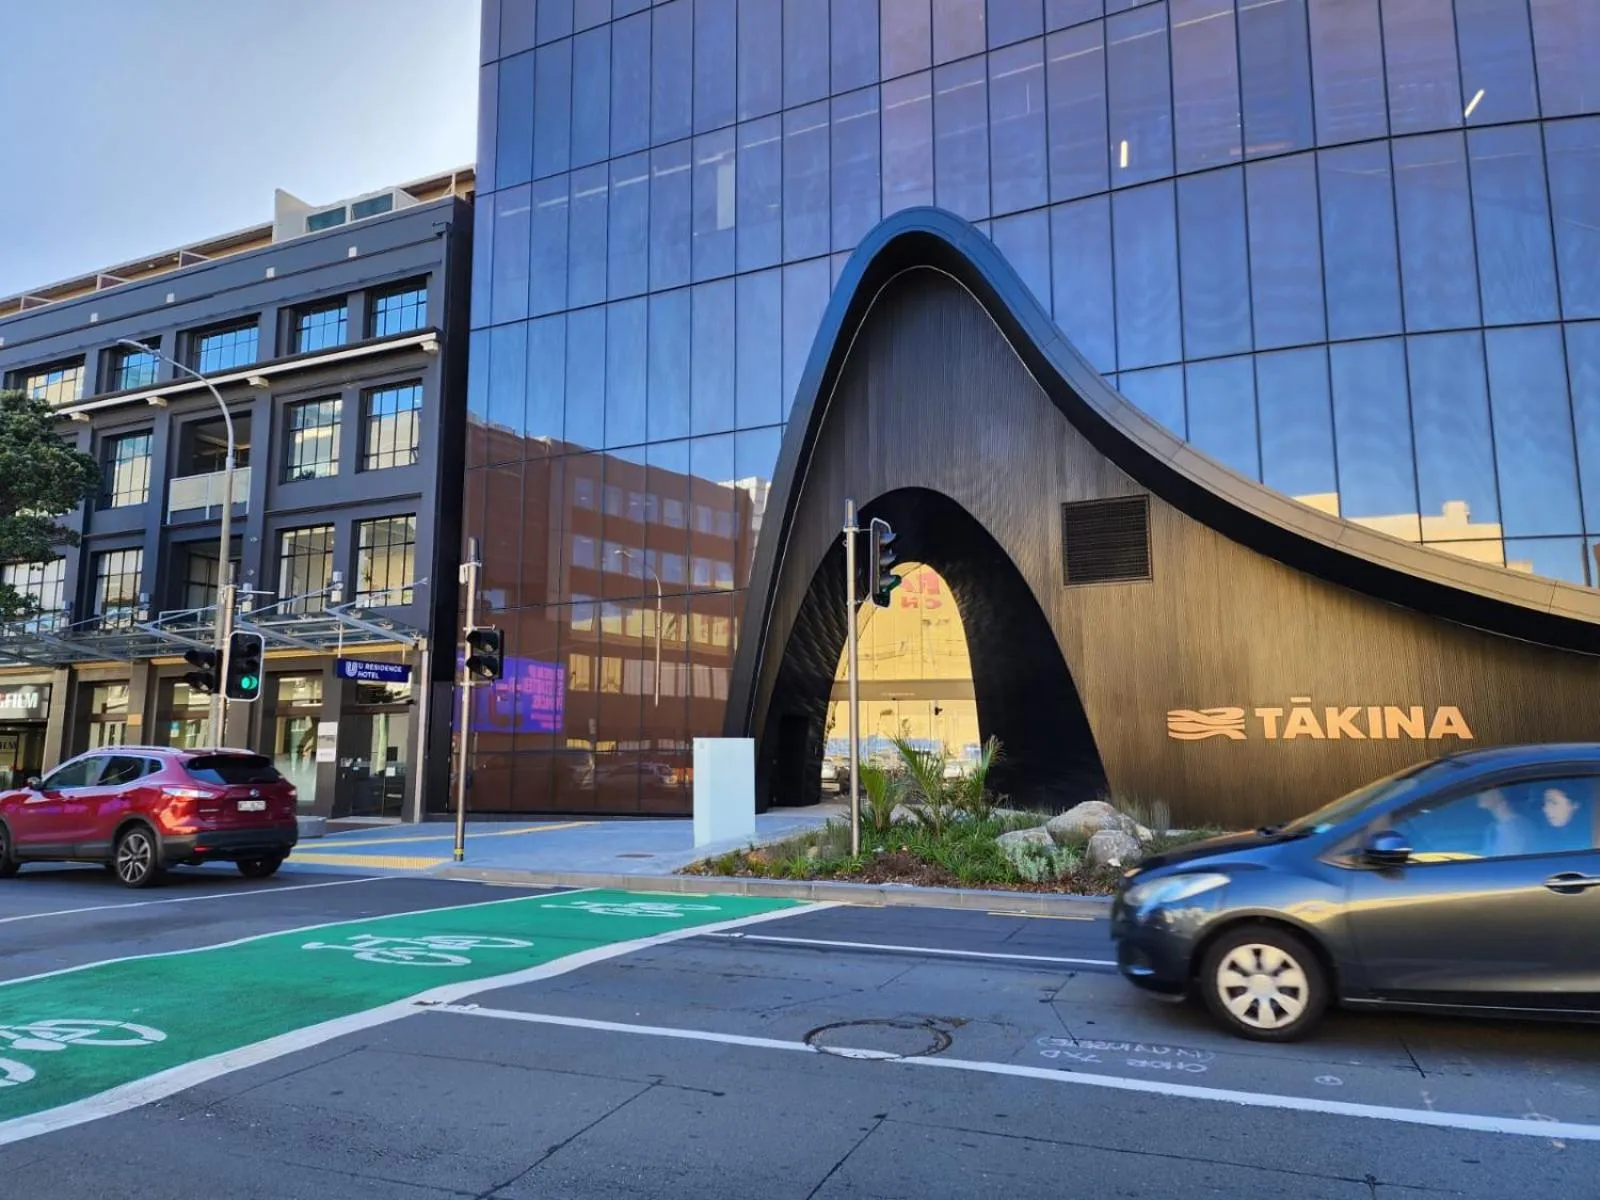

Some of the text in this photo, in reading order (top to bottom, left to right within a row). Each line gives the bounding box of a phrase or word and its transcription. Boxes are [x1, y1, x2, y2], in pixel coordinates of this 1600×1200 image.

[364, 663, 402, 673] RESIDENCE
[357, 671, 379, 679] HOTEL
[1255, 697, 1474, 739] TĀKINA
